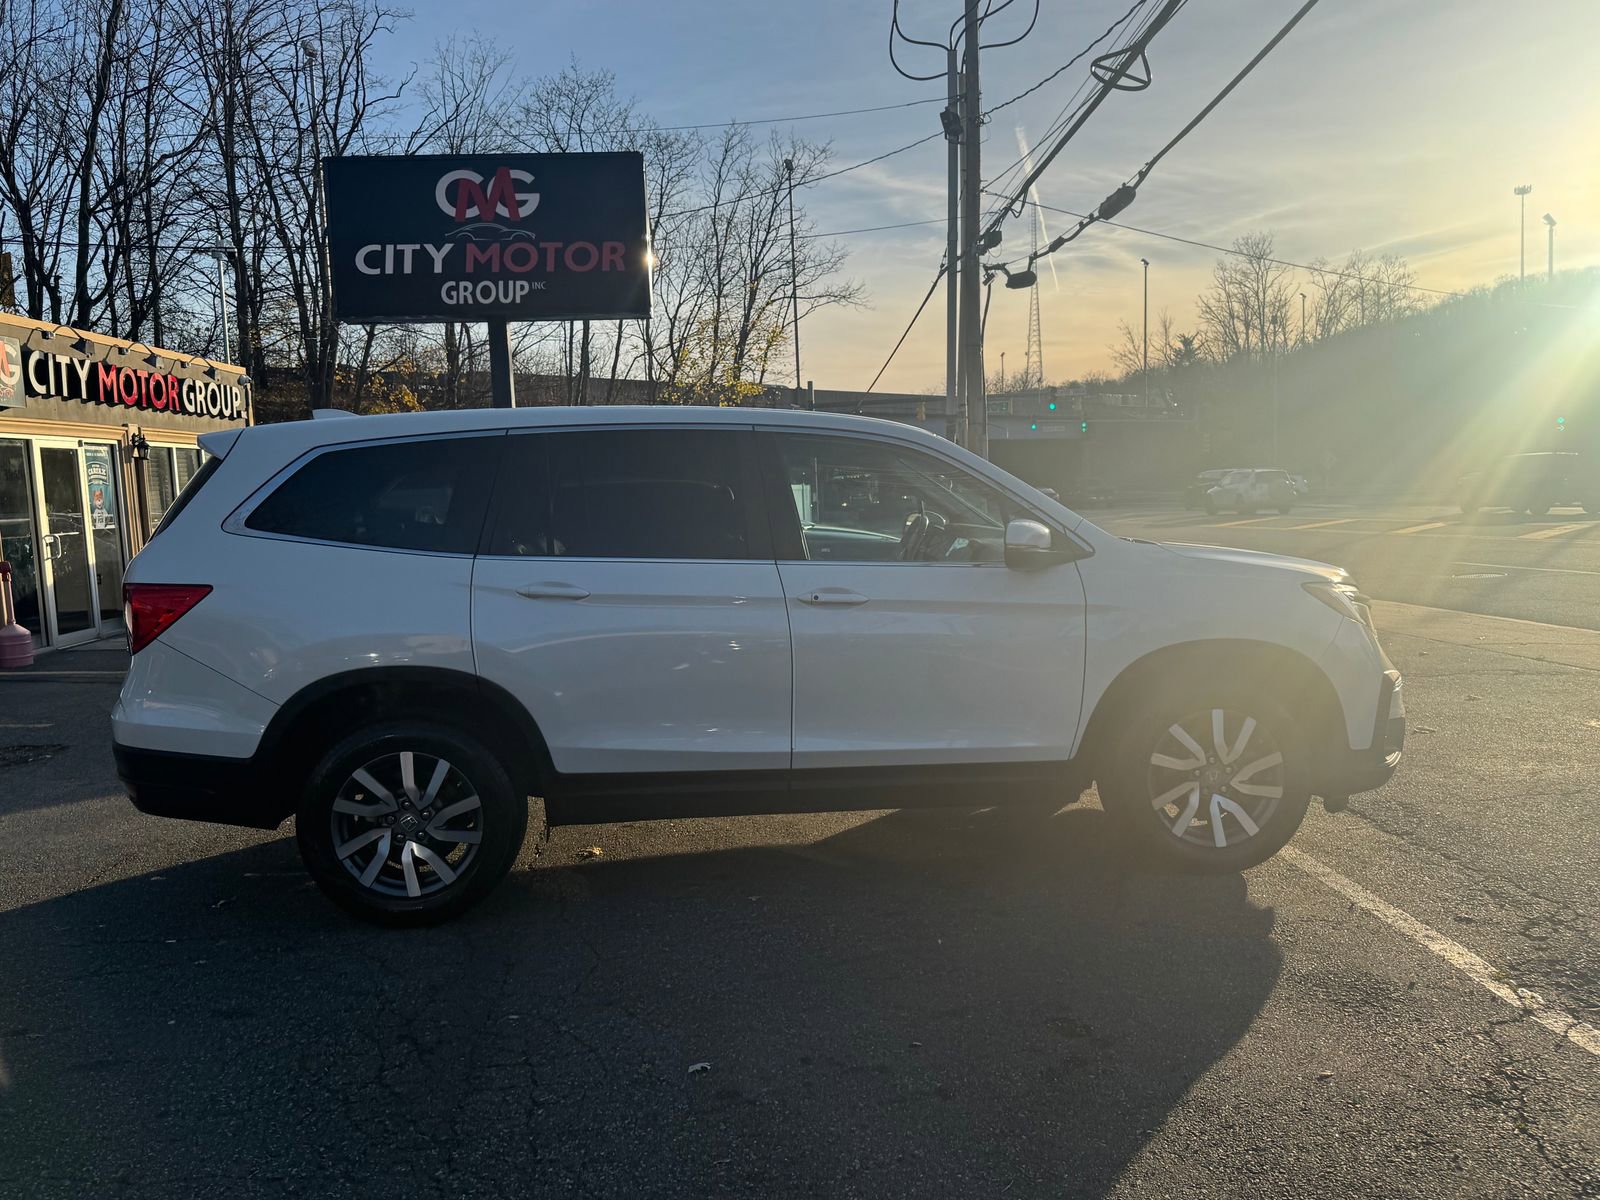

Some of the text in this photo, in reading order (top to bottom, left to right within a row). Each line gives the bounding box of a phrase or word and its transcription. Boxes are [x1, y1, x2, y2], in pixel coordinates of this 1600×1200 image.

[354, 240, 626, 276] CITY MOTOR
[440, 280, 547, 305] GROUP INC
[28, 349, 242, 419] CITY MOTOR GROUP
